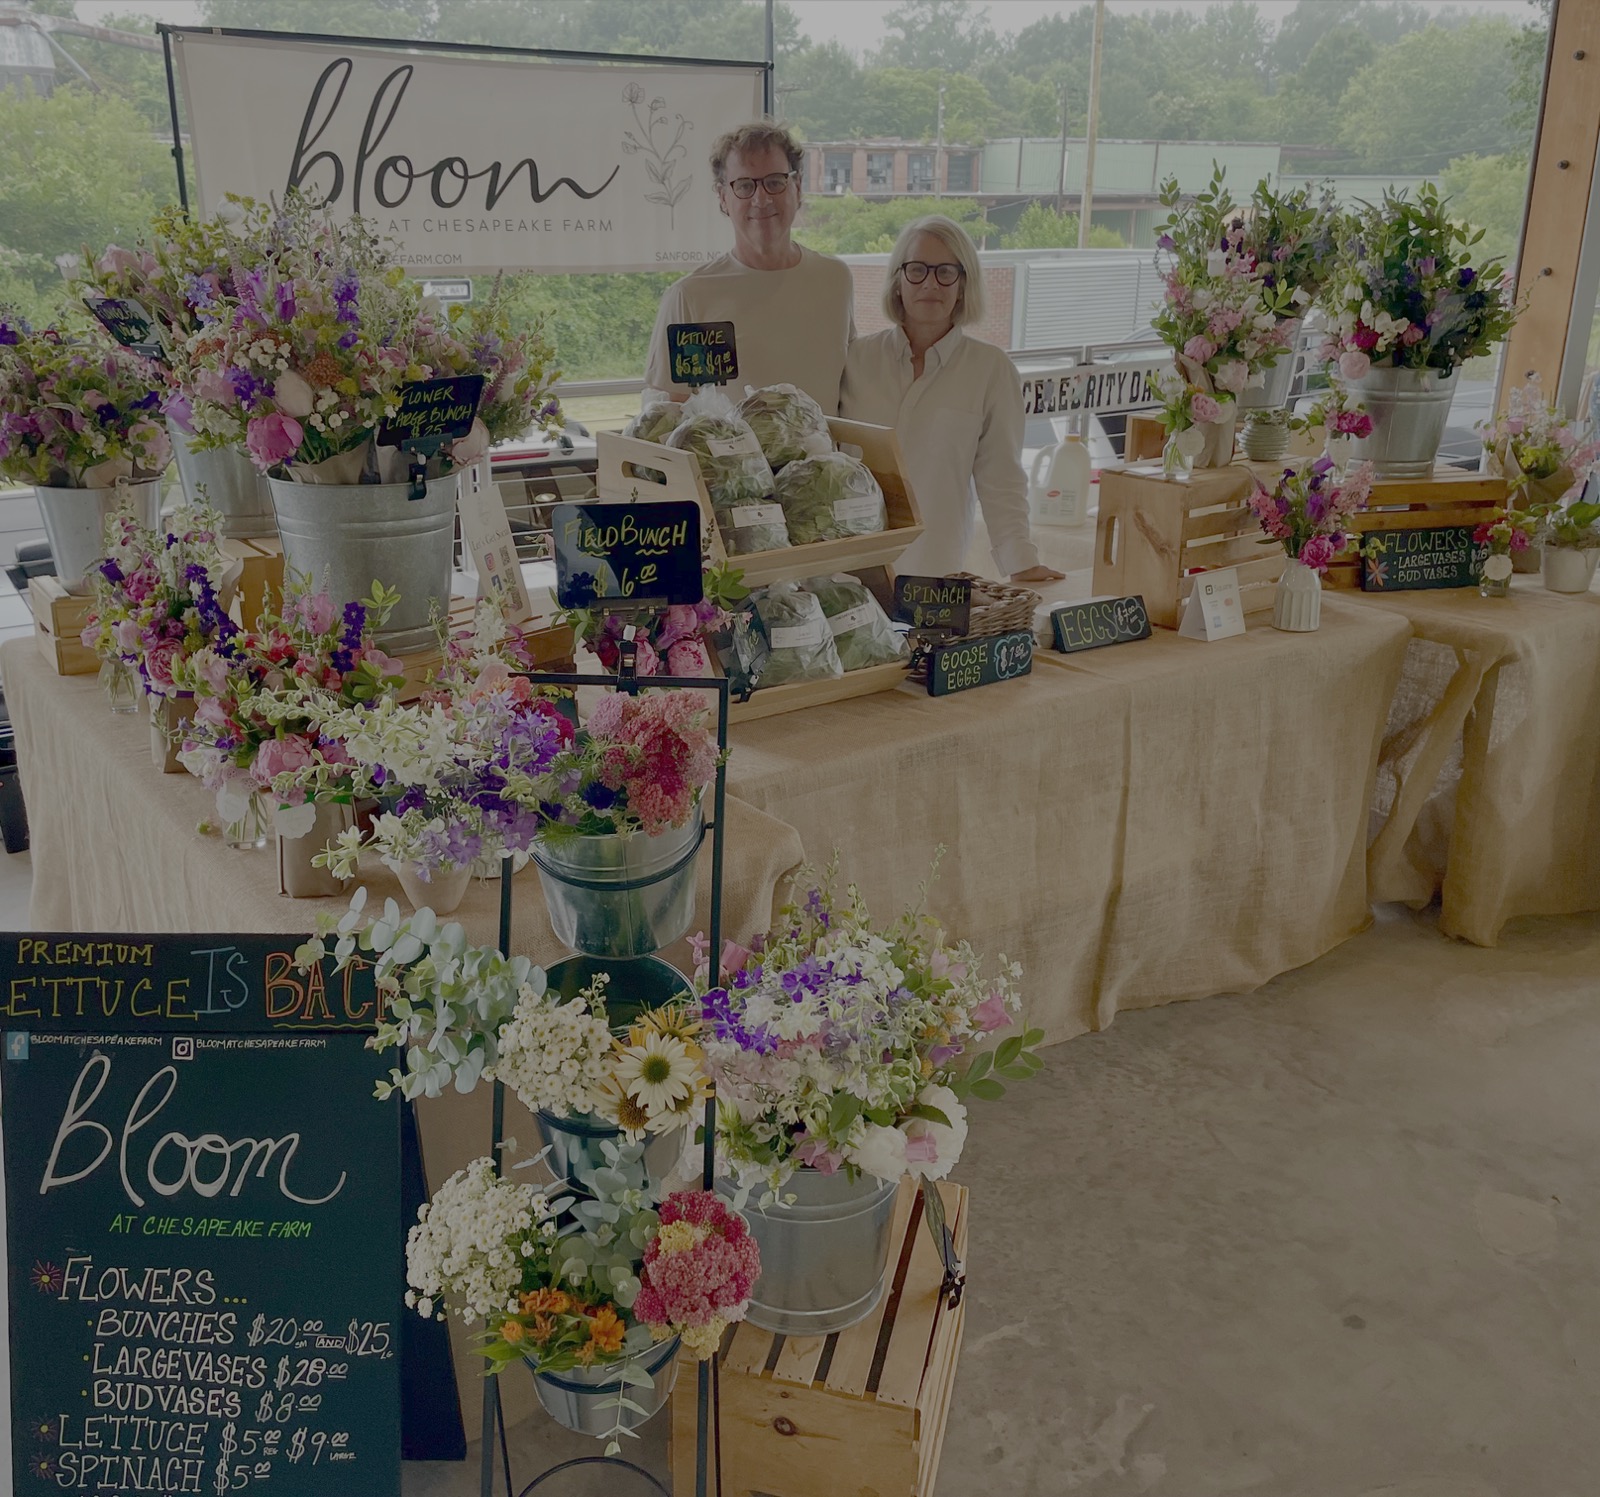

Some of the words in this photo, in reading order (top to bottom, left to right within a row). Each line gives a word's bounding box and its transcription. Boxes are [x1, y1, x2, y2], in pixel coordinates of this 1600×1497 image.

[285, 57, 620, 213] bloom
[388, 219, 411, 232] AT
[422, 219, 553, 233] CHESAPEAKE
[562, 219, 613, 232] FARM
[450, 285, 465, 295] WAY
[676, 330, 726, 347] LETTUCE
[399, 385, 455, 405] FLOWER
[386, 410, 428, 430] LARGE
[430, 403, 473, 424] BUNCH
[1383, 528, 1469, 553] FLOWERS
[903, 583, 965, 605] SPINACH
[1060, 603, 1119, 647] EGGS
[941, 643, 988, 672] GOOSE
[947, 665, 982, 690] EGGS
[17, 938, 154, 967] PREMIUM
[0, 977, 199, 1021] ETTUCE
[190, 945, 249, 1014] IS
[109, 1213, 138, 1234] AT
[143, 1215, 265, 1238] CHESAPEAKE
[268, 1219, 312, 1239] FARM
[95, 1308, 238, 1345] BUNCHES
[345, 1318, 391, 1356] $25
[317, 1337, 345, 1349] AND
[58, 1413, 209, 1456] LETTUCE
[55, 1451, 206, 1492] SPINACH
